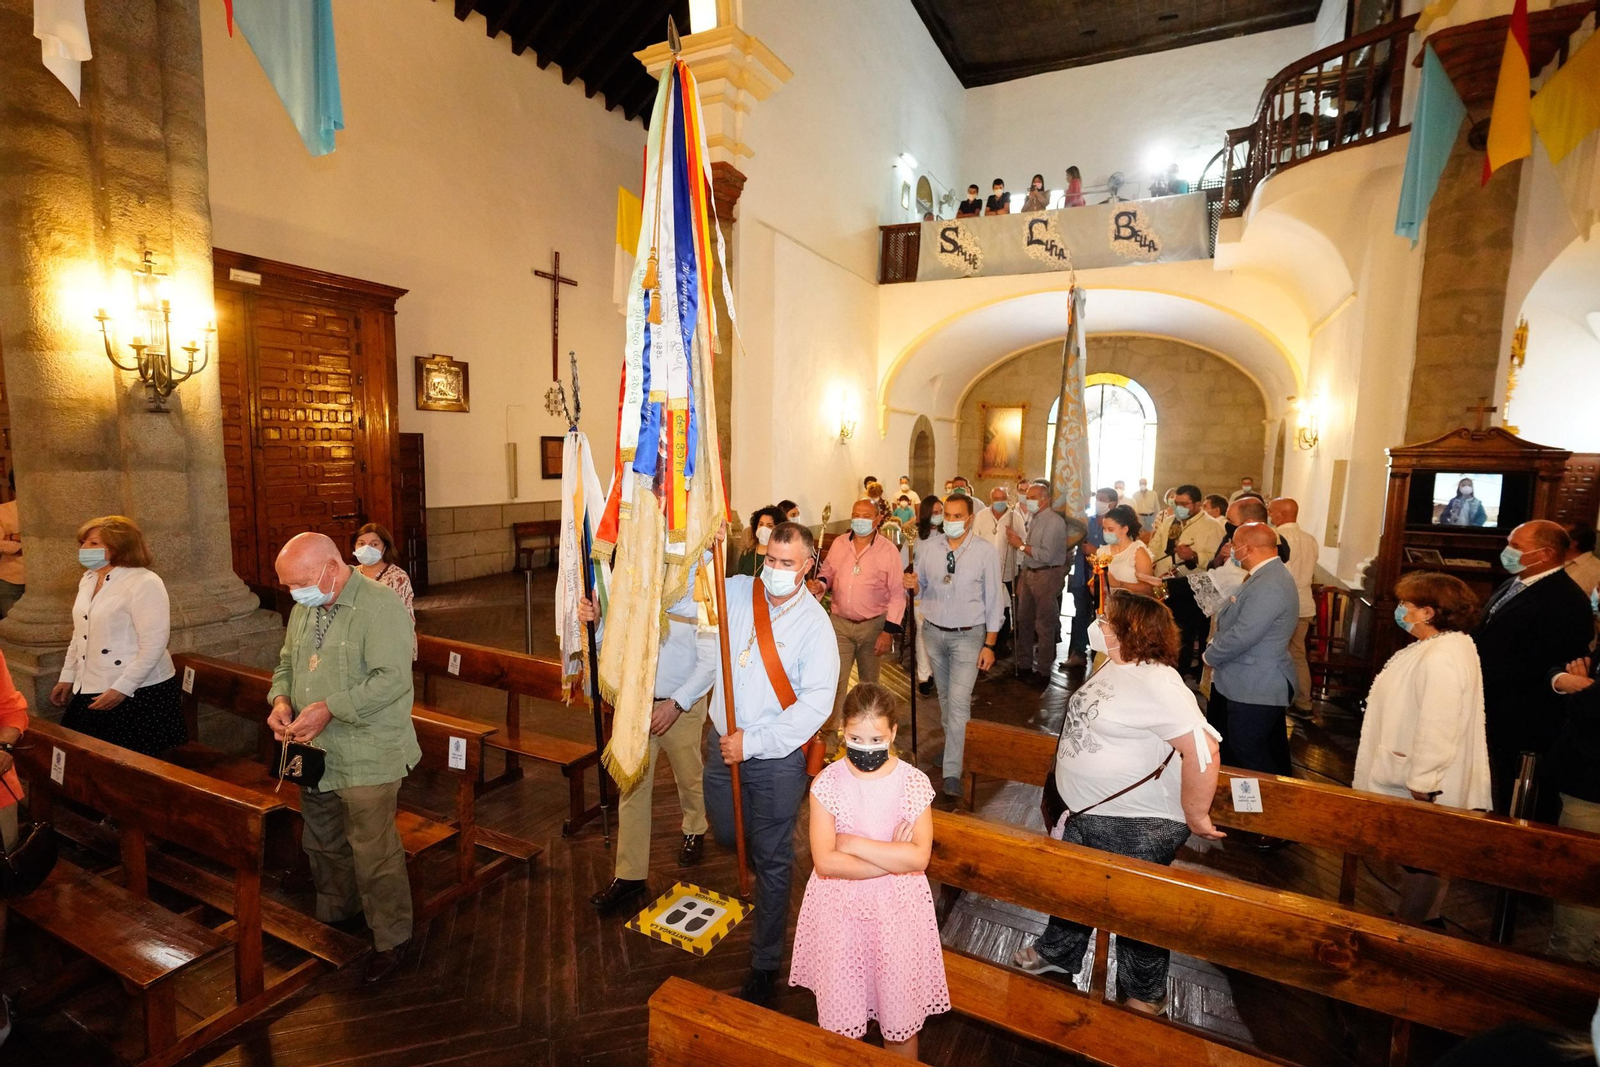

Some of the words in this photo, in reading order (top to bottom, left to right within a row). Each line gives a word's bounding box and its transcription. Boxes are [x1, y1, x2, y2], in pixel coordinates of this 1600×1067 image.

[284, 755, 302, 776] A
[695, 893, 726, 905] DISTANCIA
[650, 922, 659, 930] LA
[659, 926, 694, 942] MANTENGA
